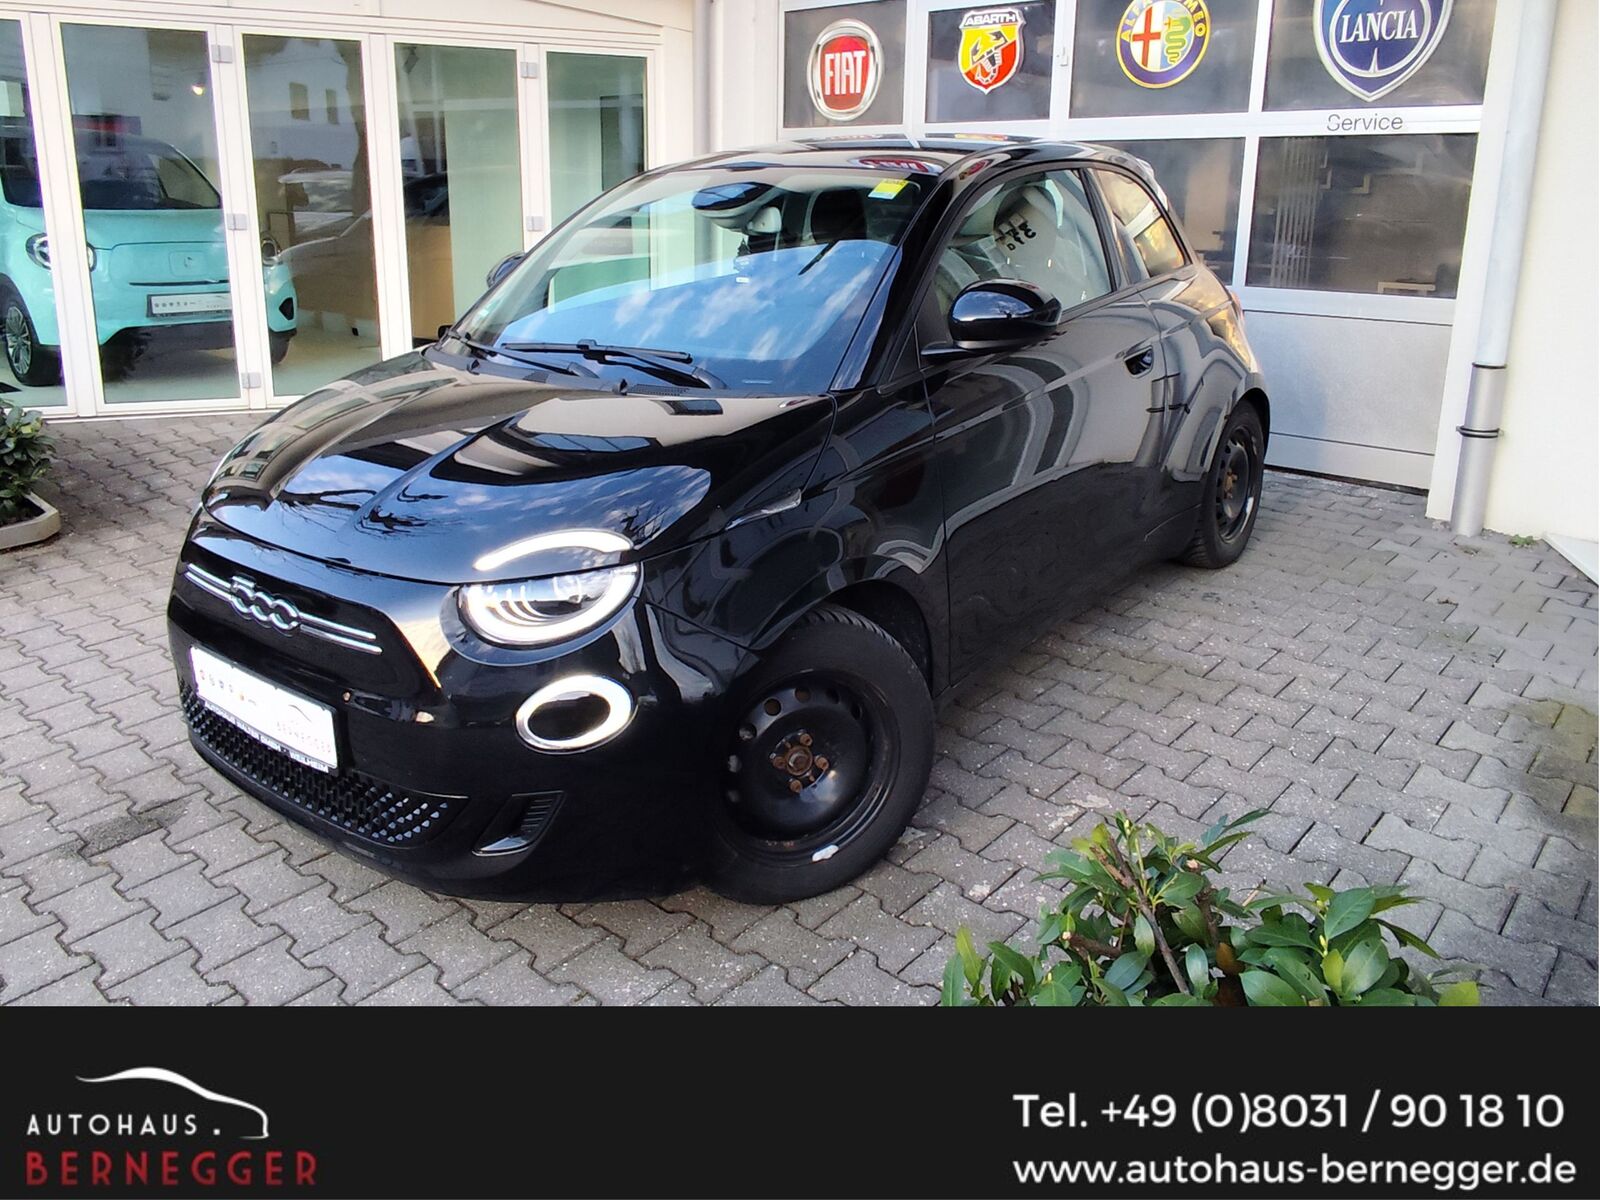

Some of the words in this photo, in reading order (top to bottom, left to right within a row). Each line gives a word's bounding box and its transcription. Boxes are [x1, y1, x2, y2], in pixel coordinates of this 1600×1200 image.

[965, 13, 1016, 26] ABARTH
[1339, 9, 1419, 43] LANCIA
[824, 50, 867, 96] FIAT
[1326, 112, 1404, 132] Service
[230, 575, 299, 630] 500
